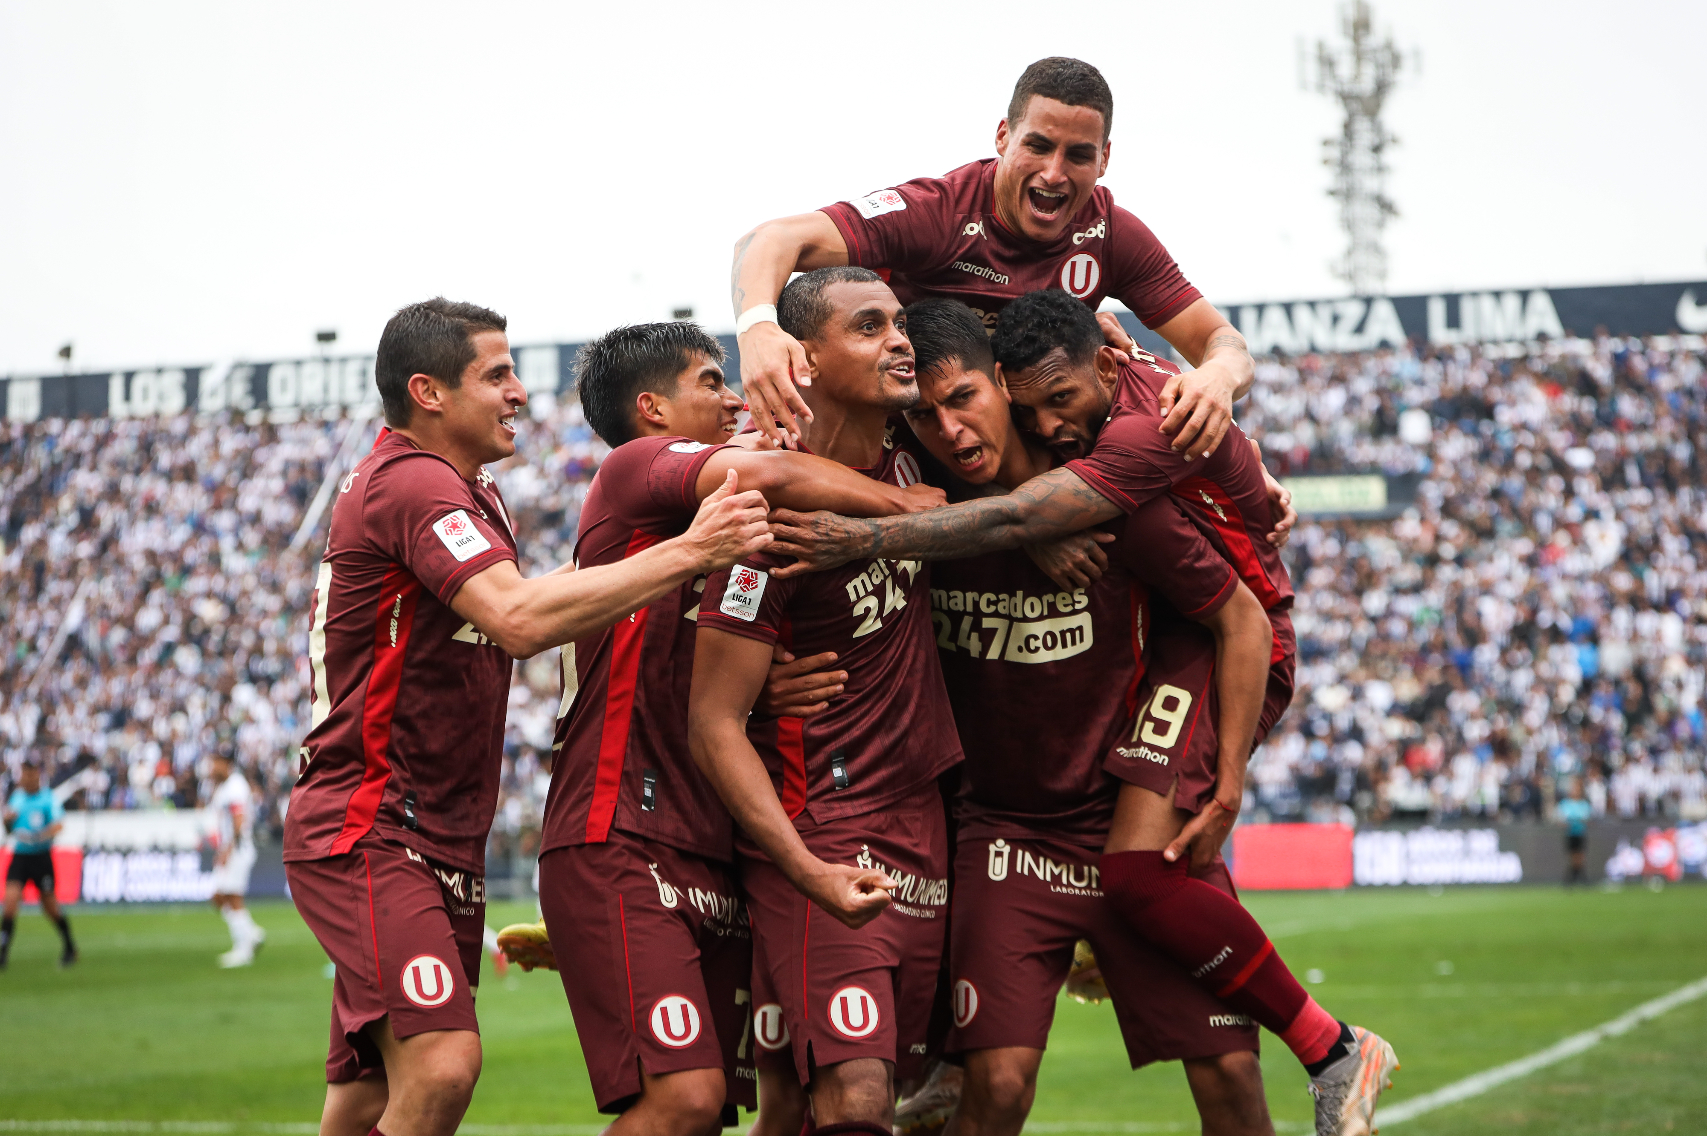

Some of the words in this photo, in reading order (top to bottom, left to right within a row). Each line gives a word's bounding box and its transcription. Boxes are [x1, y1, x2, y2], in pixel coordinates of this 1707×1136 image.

[951, 261, 1009, 285] marathon
[1218, 296, 1407, 352] IANZA
[1426, 289, 1566, 344] LIMA
[107, 370, 188, 422] LOS
[721, 603, 755, 619] betsson
[929, 586, 1090, 619] marcadores
[1116, 745, 1169, 766] marathon
